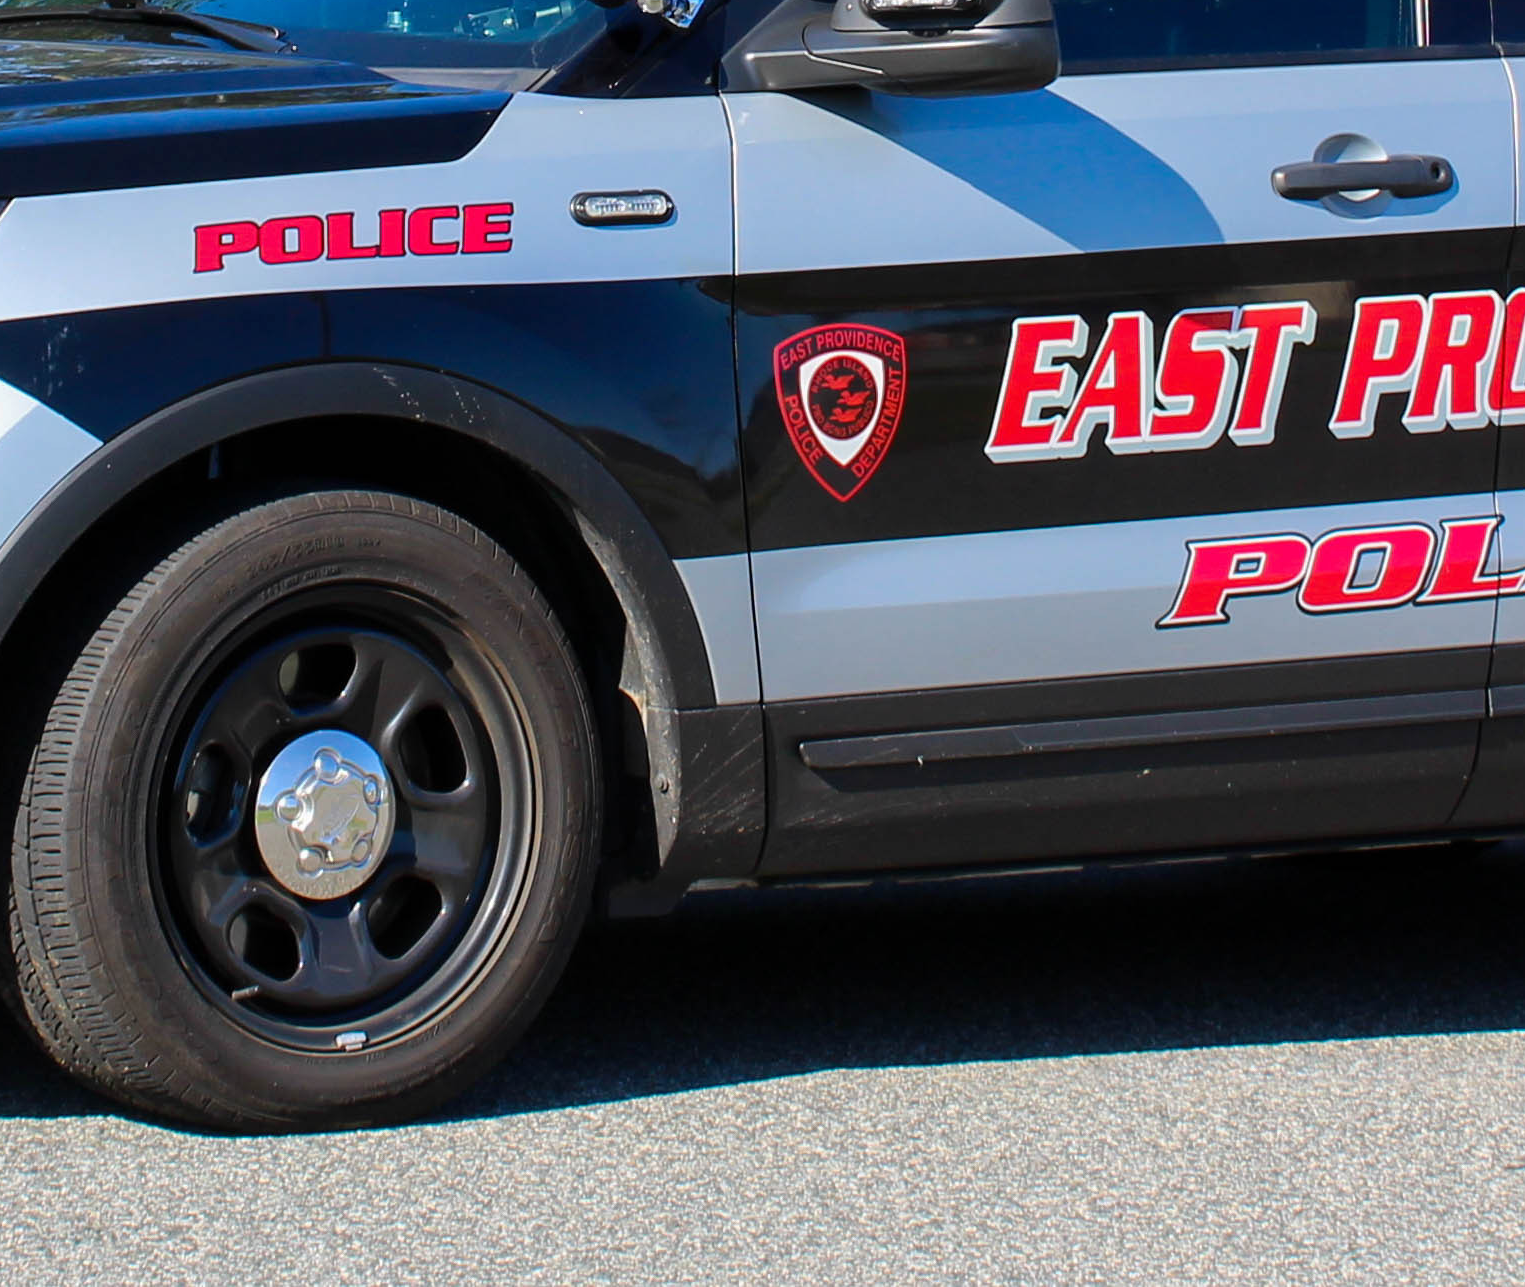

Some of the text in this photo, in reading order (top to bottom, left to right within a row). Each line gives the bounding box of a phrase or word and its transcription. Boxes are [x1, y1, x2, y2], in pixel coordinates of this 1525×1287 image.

[193, 203, 514, 273] POLICE
[781, 330, 901, 370] EAST PROVIDENCE
[983, 301, 1315, 463] EAST
[784, 395, 823, 465] POLICE
[852, 368, 901, 478] DEPARTMENT
